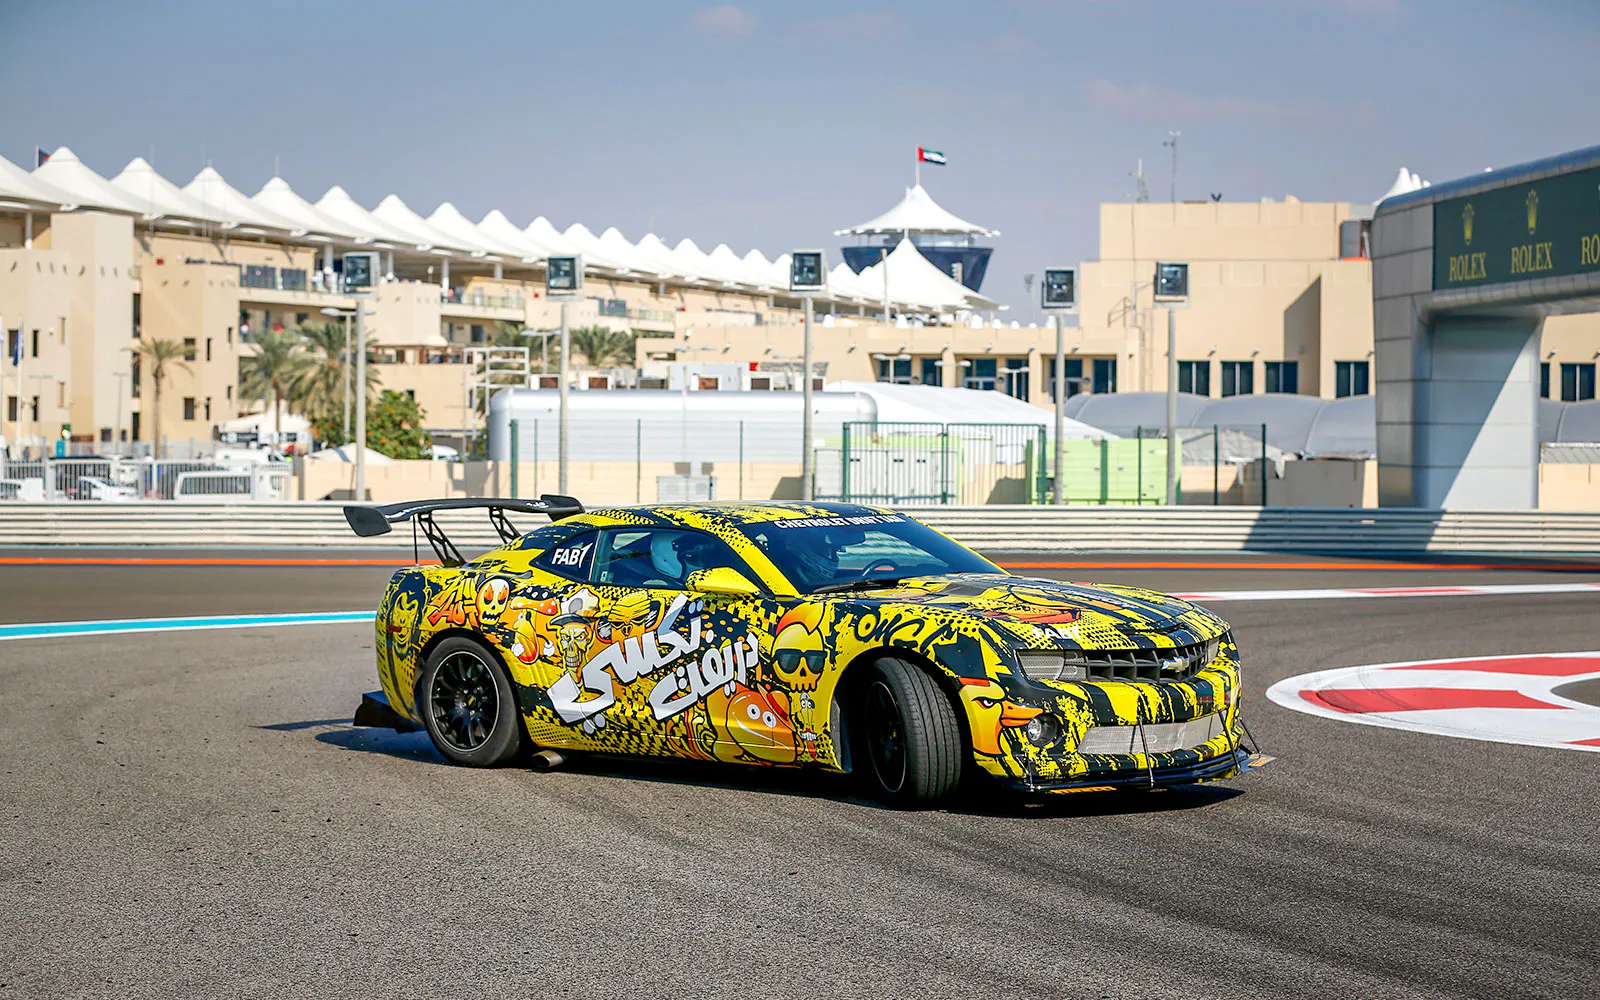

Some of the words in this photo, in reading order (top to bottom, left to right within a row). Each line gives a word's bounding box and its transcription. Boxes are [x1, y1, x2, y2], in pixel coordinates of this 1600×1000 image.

[1449, 252, 1486, 281] ROLEX
[1511, 242, 1553, 273] ROLEX
[773, 517, 850, 529] CHEVROLET
